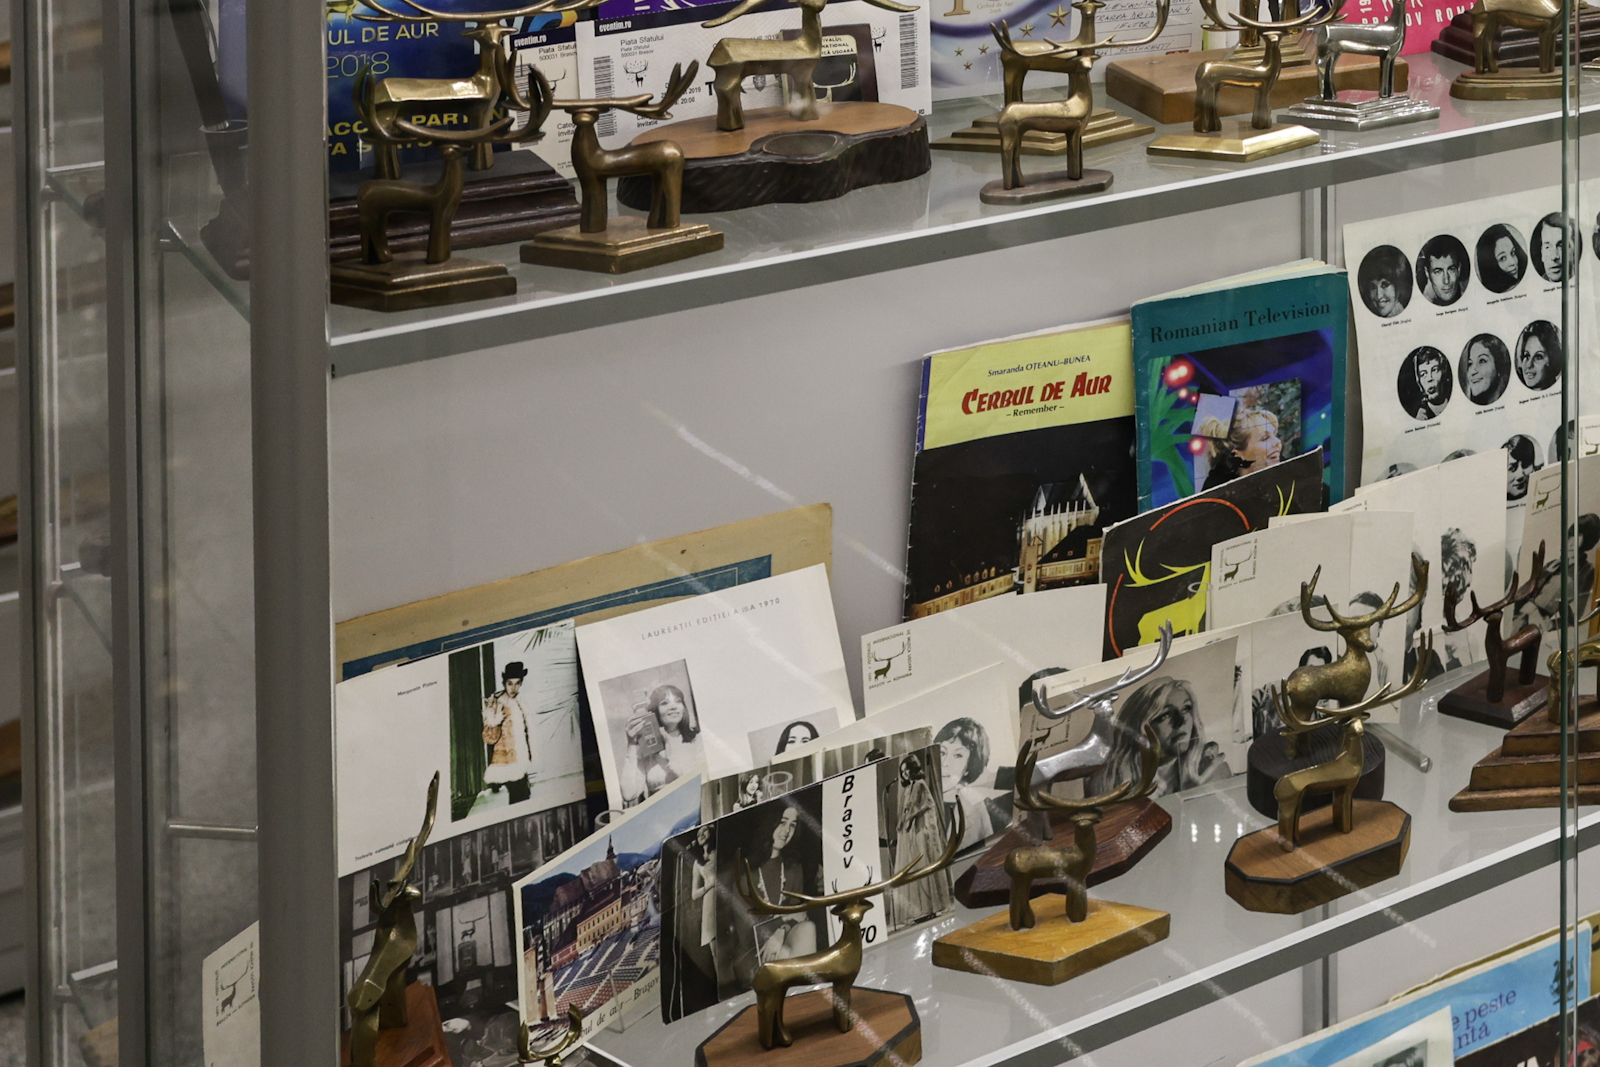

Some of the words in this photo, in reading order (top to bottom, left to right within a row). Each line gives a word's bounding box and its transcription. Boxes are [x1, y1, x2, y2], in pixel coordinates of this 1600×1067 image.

[362, 25, 389, 42] DE
[395, 22, 439, 40] AUR
[599, 21, 632, 33] eventim.ro
[514, 35, 547, 48] eventim.ro
[620, 37, 637, 46] Piata
[639, 34, 664, 44] Sfatului
[1150, 317, 1239, 344] Romanian
[1244, 302, 1331, 328] Television
[987, 364, 1024, 377] Smaranda
[961, 385, 1034, 415] CERBUL
[1040, 381, 1065, 401] DE
[1071, 371, 1112, 397] AUR
[1012, 404, 1058, 418] Remember
[759, 597, 780, 607] 1970
[842, 775, 854, 869] Brasov
[1464, 989, 1517, 1031] peste
